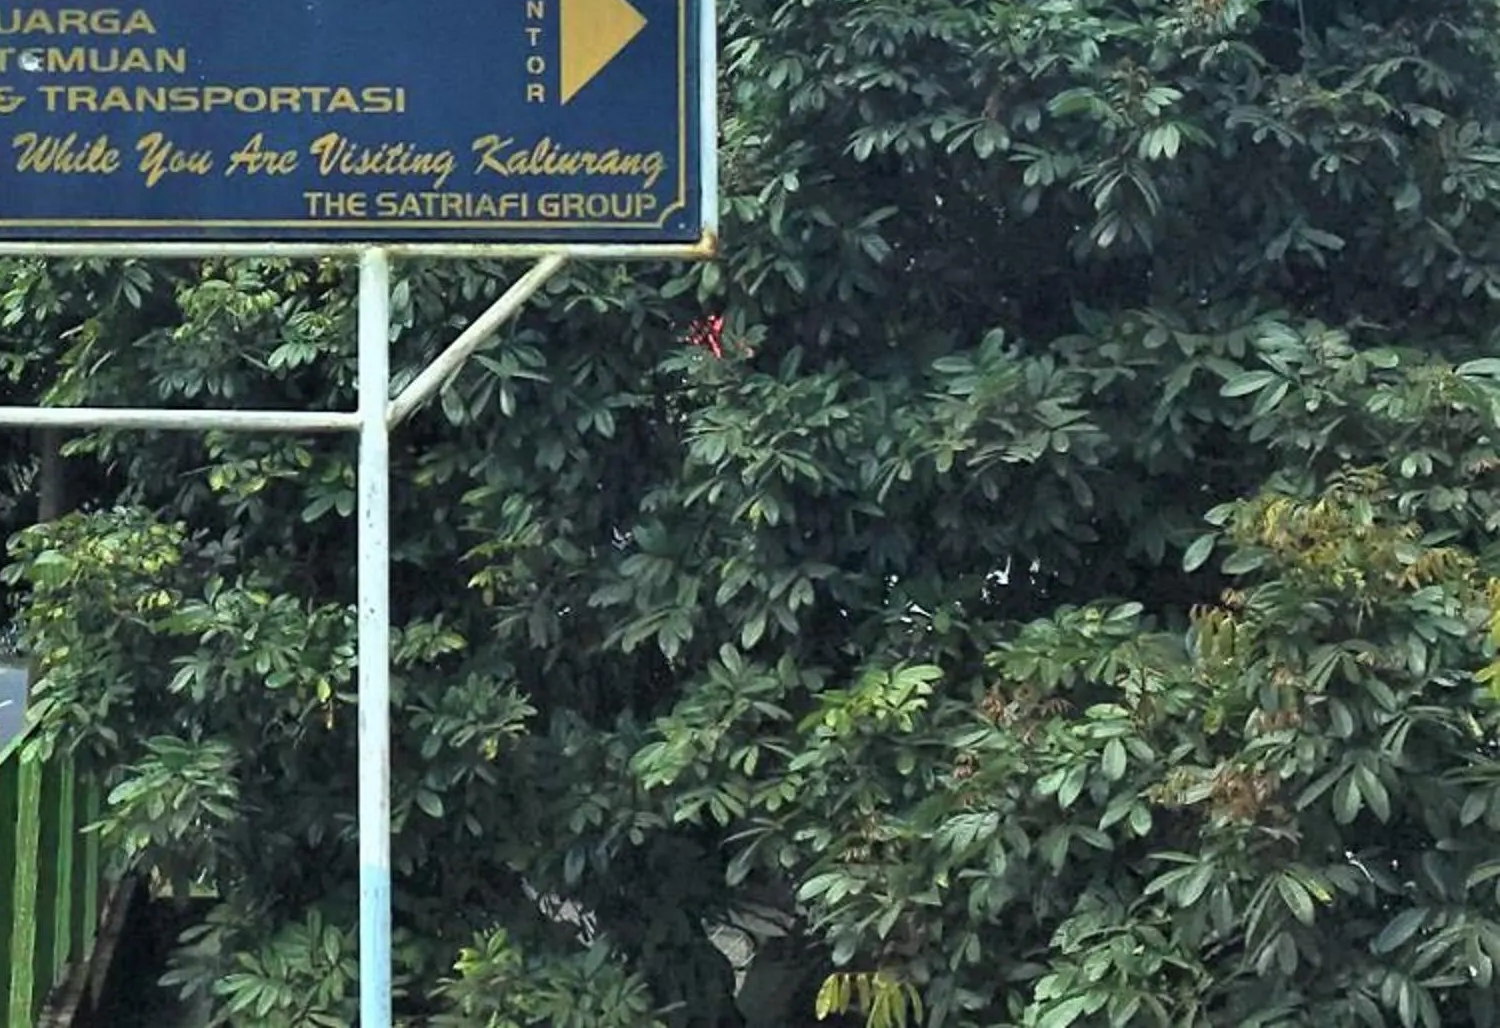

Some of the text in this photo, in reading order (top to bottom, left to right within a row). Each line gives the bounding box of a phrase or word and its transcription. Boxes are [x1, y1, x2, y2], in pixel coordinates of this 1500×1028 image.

[37, 85, 406, 114] TRANSPORTASI
[11, 131, 122, 174] While
[135, 131, 214, 188] You
[223, 132, 299, 176] Are
[308, 131, 456, 189] Visiting
[471, 133, 666, 189] Kaliurang
[303, 191, 657, 219] THE SATRIAFI GROUP
